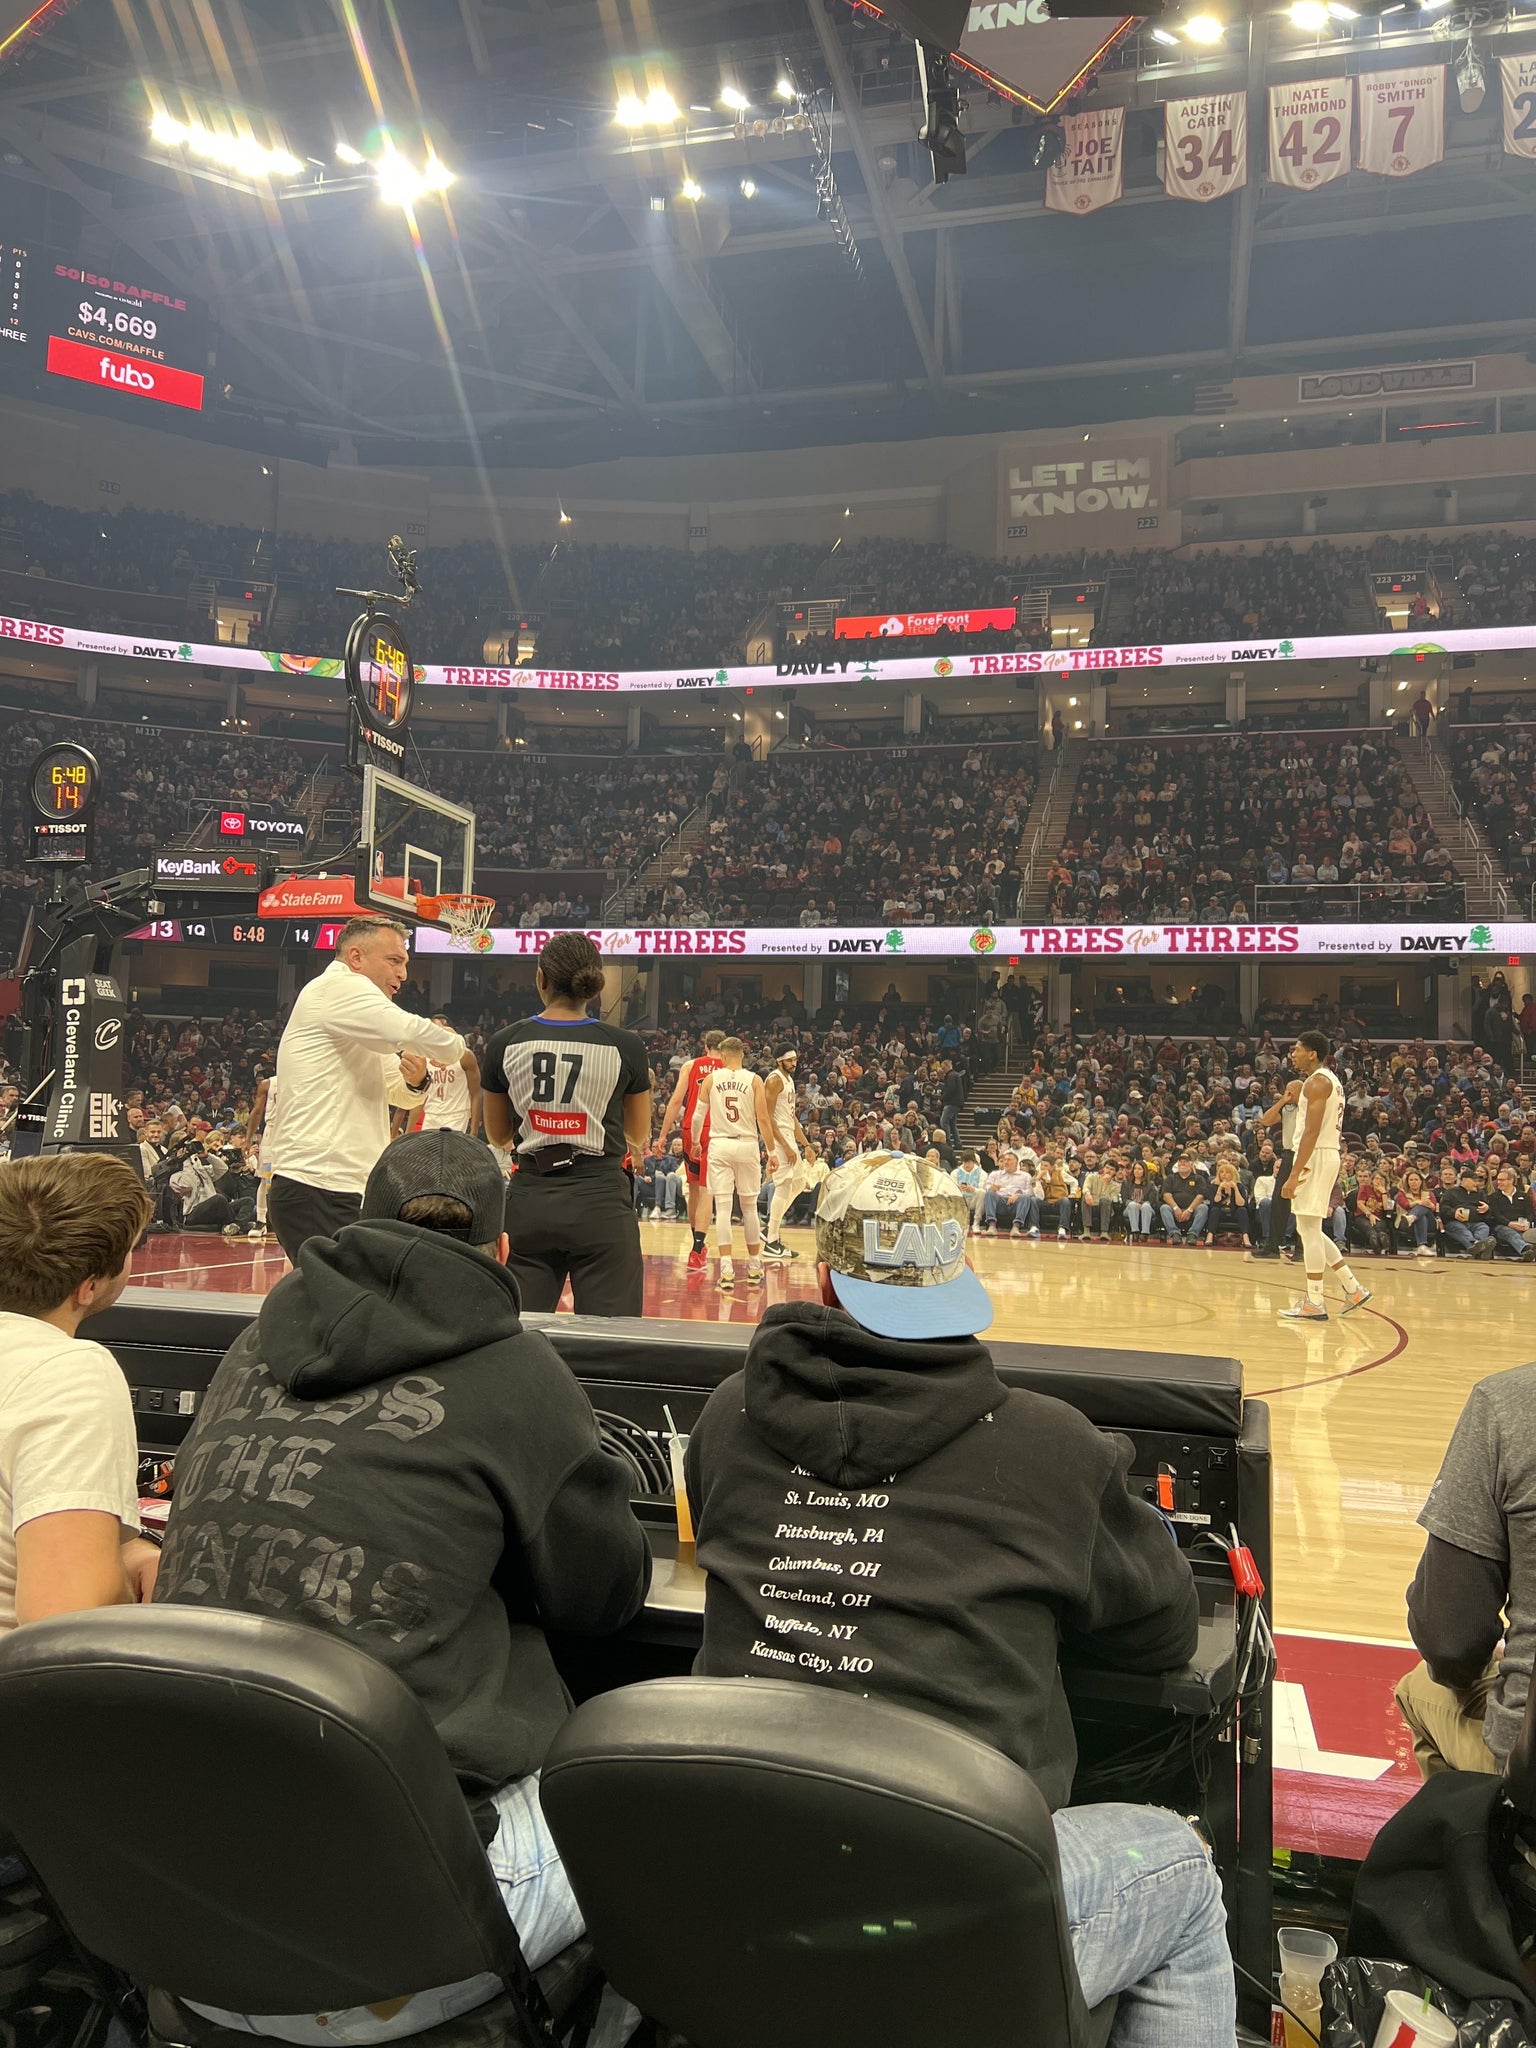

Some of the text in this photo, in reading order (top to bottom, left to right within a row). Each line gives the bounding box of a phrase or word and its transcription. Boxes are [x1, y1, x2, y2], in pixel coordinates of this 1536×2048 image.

[1292, 87, 1329, 101] NATE
[1366, 82, 1397, 91] BOBBY
[1377, 88, 1425, 104] SMITH
[1180, 101, 1232, 117] AUSTIN
[1274, 99, 1346, 118] THURMOND
[1071, 119, 1117, 131] SEASONS
[1187, 115, 1226, 130] CARR
[1388, 106, 1415, 153] 7
[1074, 137, 1113, 158] JOE
[1278, 116, 1341, 167] 42
[1176, 129, 1237, 181] 34
[1071, 155, 1116, 177] TAIT
[12, 247, 28, 258] PTS
[113, 281, 187, 311] RAFFLE
[78, 301, 157, 340] $4,669
[0, 327, 28, 343] HREE
[67, 326, 165, 360] CAVS.COM/RAFFLE
[100, 357, 155, 390] fubo
[1008, 457, 1150, 490] LET EM
[1009, 484, 1159, 518] KNOW.
[1008, 527, 1027, 538] 222
[1138, 518, 1158, 529] 223
[1376, 576, 1392, 584] 223
[907, 612, 970, 626] ForeFront
[0, 617, 177, 660] REES Presented by DAVEY
[376, 637, 405, 677] 6:48
[969, 647, 1277, 675] TREES For THREES Presented by DAVEY
[443, 667, 715, 691] TREES For THREES Presented by DAVEY
[145, 727, 162, 737] 117
[372, 730, 405, 758] TISSOT
[52, 765, 86, 785] 6:48
[56, 786, 79, 809] 14
[48, 823, 87, 834] TISSOT
[248, 819, 304, 835] TOYOTA
[157, 858, 221, 876] KeyBank
[150, 920, 173, 938] 13
[186, 924, 206, 937] 1Q
[233, 925, 265, 943] 6:48
[295, 929, 309, 944] 14
[604, 932, 632, 954] For
[634, 930, 746, 954] THREES
[761, 943, 808, 953] Presented
[810, 942, 823, 955] by
[828, 939, 884, 953] DAVEY
[1020, 926, 1469, 954] TREES For THREES Presented by DAVEY
[94, 979, 112, 990] SEAT
[97, 988, 116, 998] GEEK
[53, 1008, 81, 1138] Cleveland Clinic
[430, 1069, 455, 1084] AVS
[532, 1051, 583, 1104] 87
[436, 1088, 445, 1101] 4
[716, 1081, 748, 1095] MERRILL
[725, 1096, 740, 1123] 5
[89, 1115, 120, 1138] Elk
[534, 1114, 581, 1130] Emirates
[876, 1178, 906, 1189] EDGE
[880, 1220, 899, 1231] THE
[862, 1218, 964, 1268] LAND
[784, 1491, 890, 1510] St. Louis, MO
[775, 1524, 885, 1546] Pittsburgh, PA
[768, 1556, 881, 1577] Columbus, OH
[759, 1583, 872, 1608] Cleveland, OH
[764, 1614, 859, 1640] Buffalo, NY
[750, 1640, 874, 1674] Kansas City, MO
